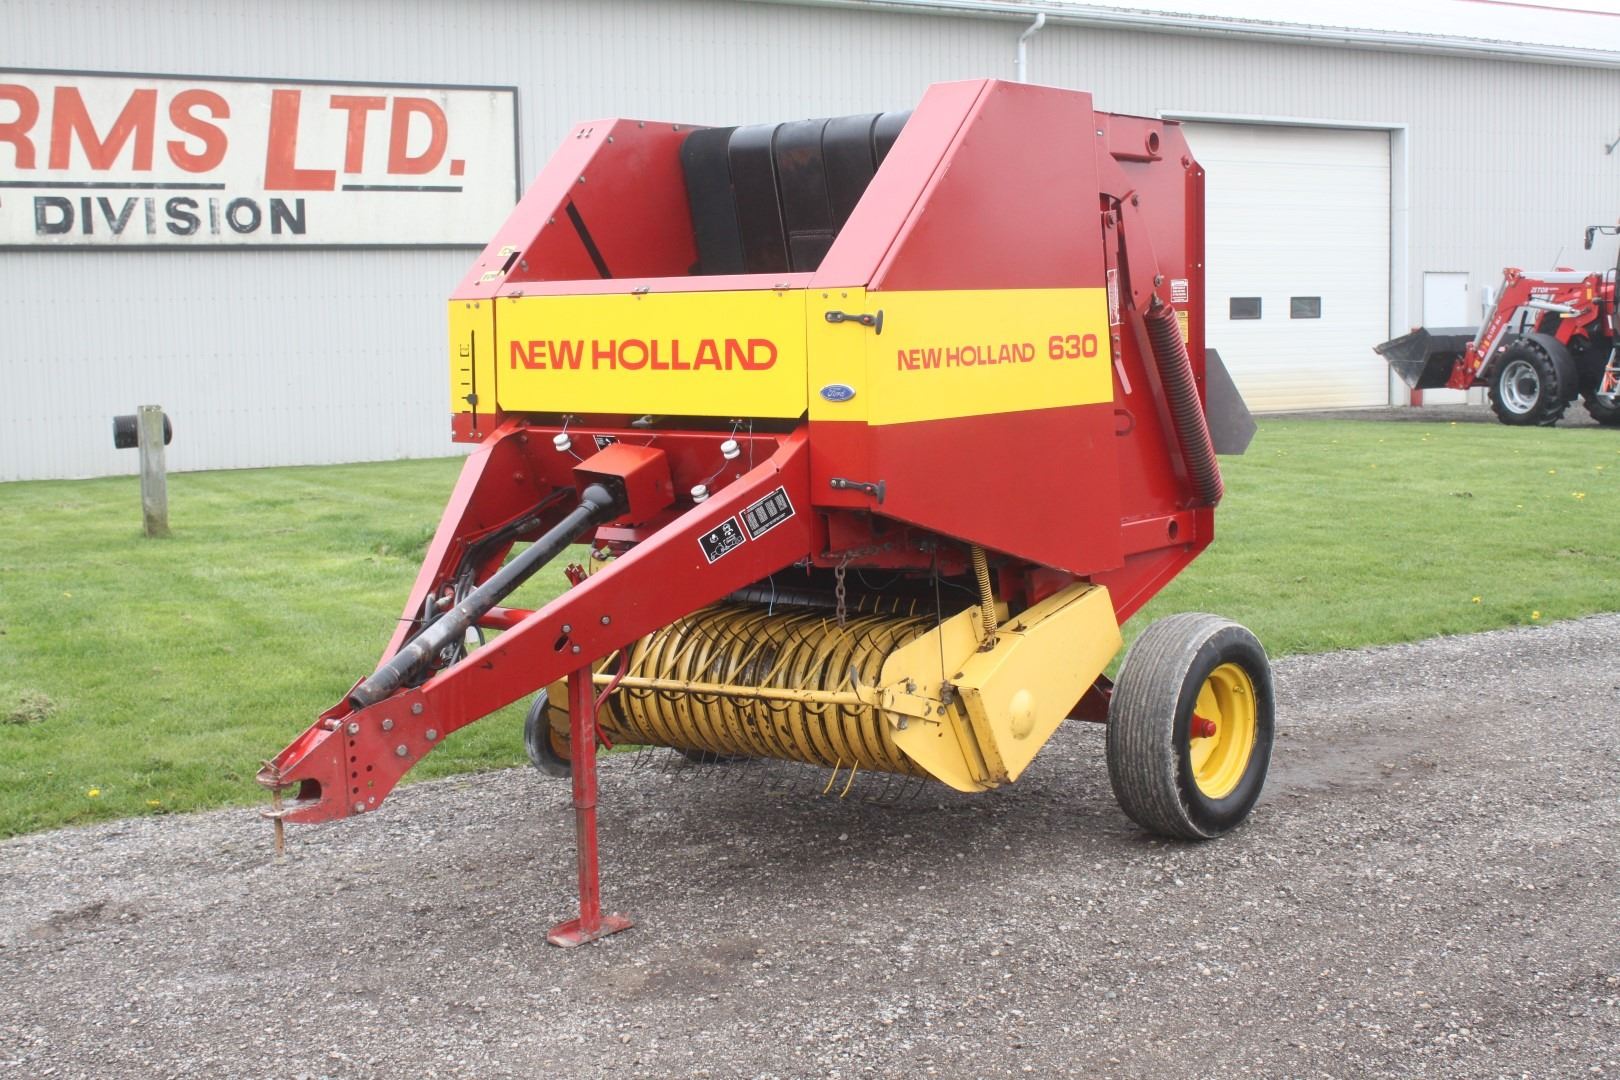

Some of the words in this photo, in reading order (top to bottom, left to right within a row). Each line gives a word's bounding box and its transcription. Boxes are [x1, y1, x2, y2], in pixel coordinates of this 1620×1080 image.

[264, 88, 467, 191] LTD.
[34, 196, 306, 236] DIVISION
[510, 340, 584, 370] NEW
[592, 338, 778, 371] HOLLAND
[897, 347, 943, 371] NEW
[946, 342, 1036, 368] HOLLAND
[1048, 334, 1098, 361] 630
